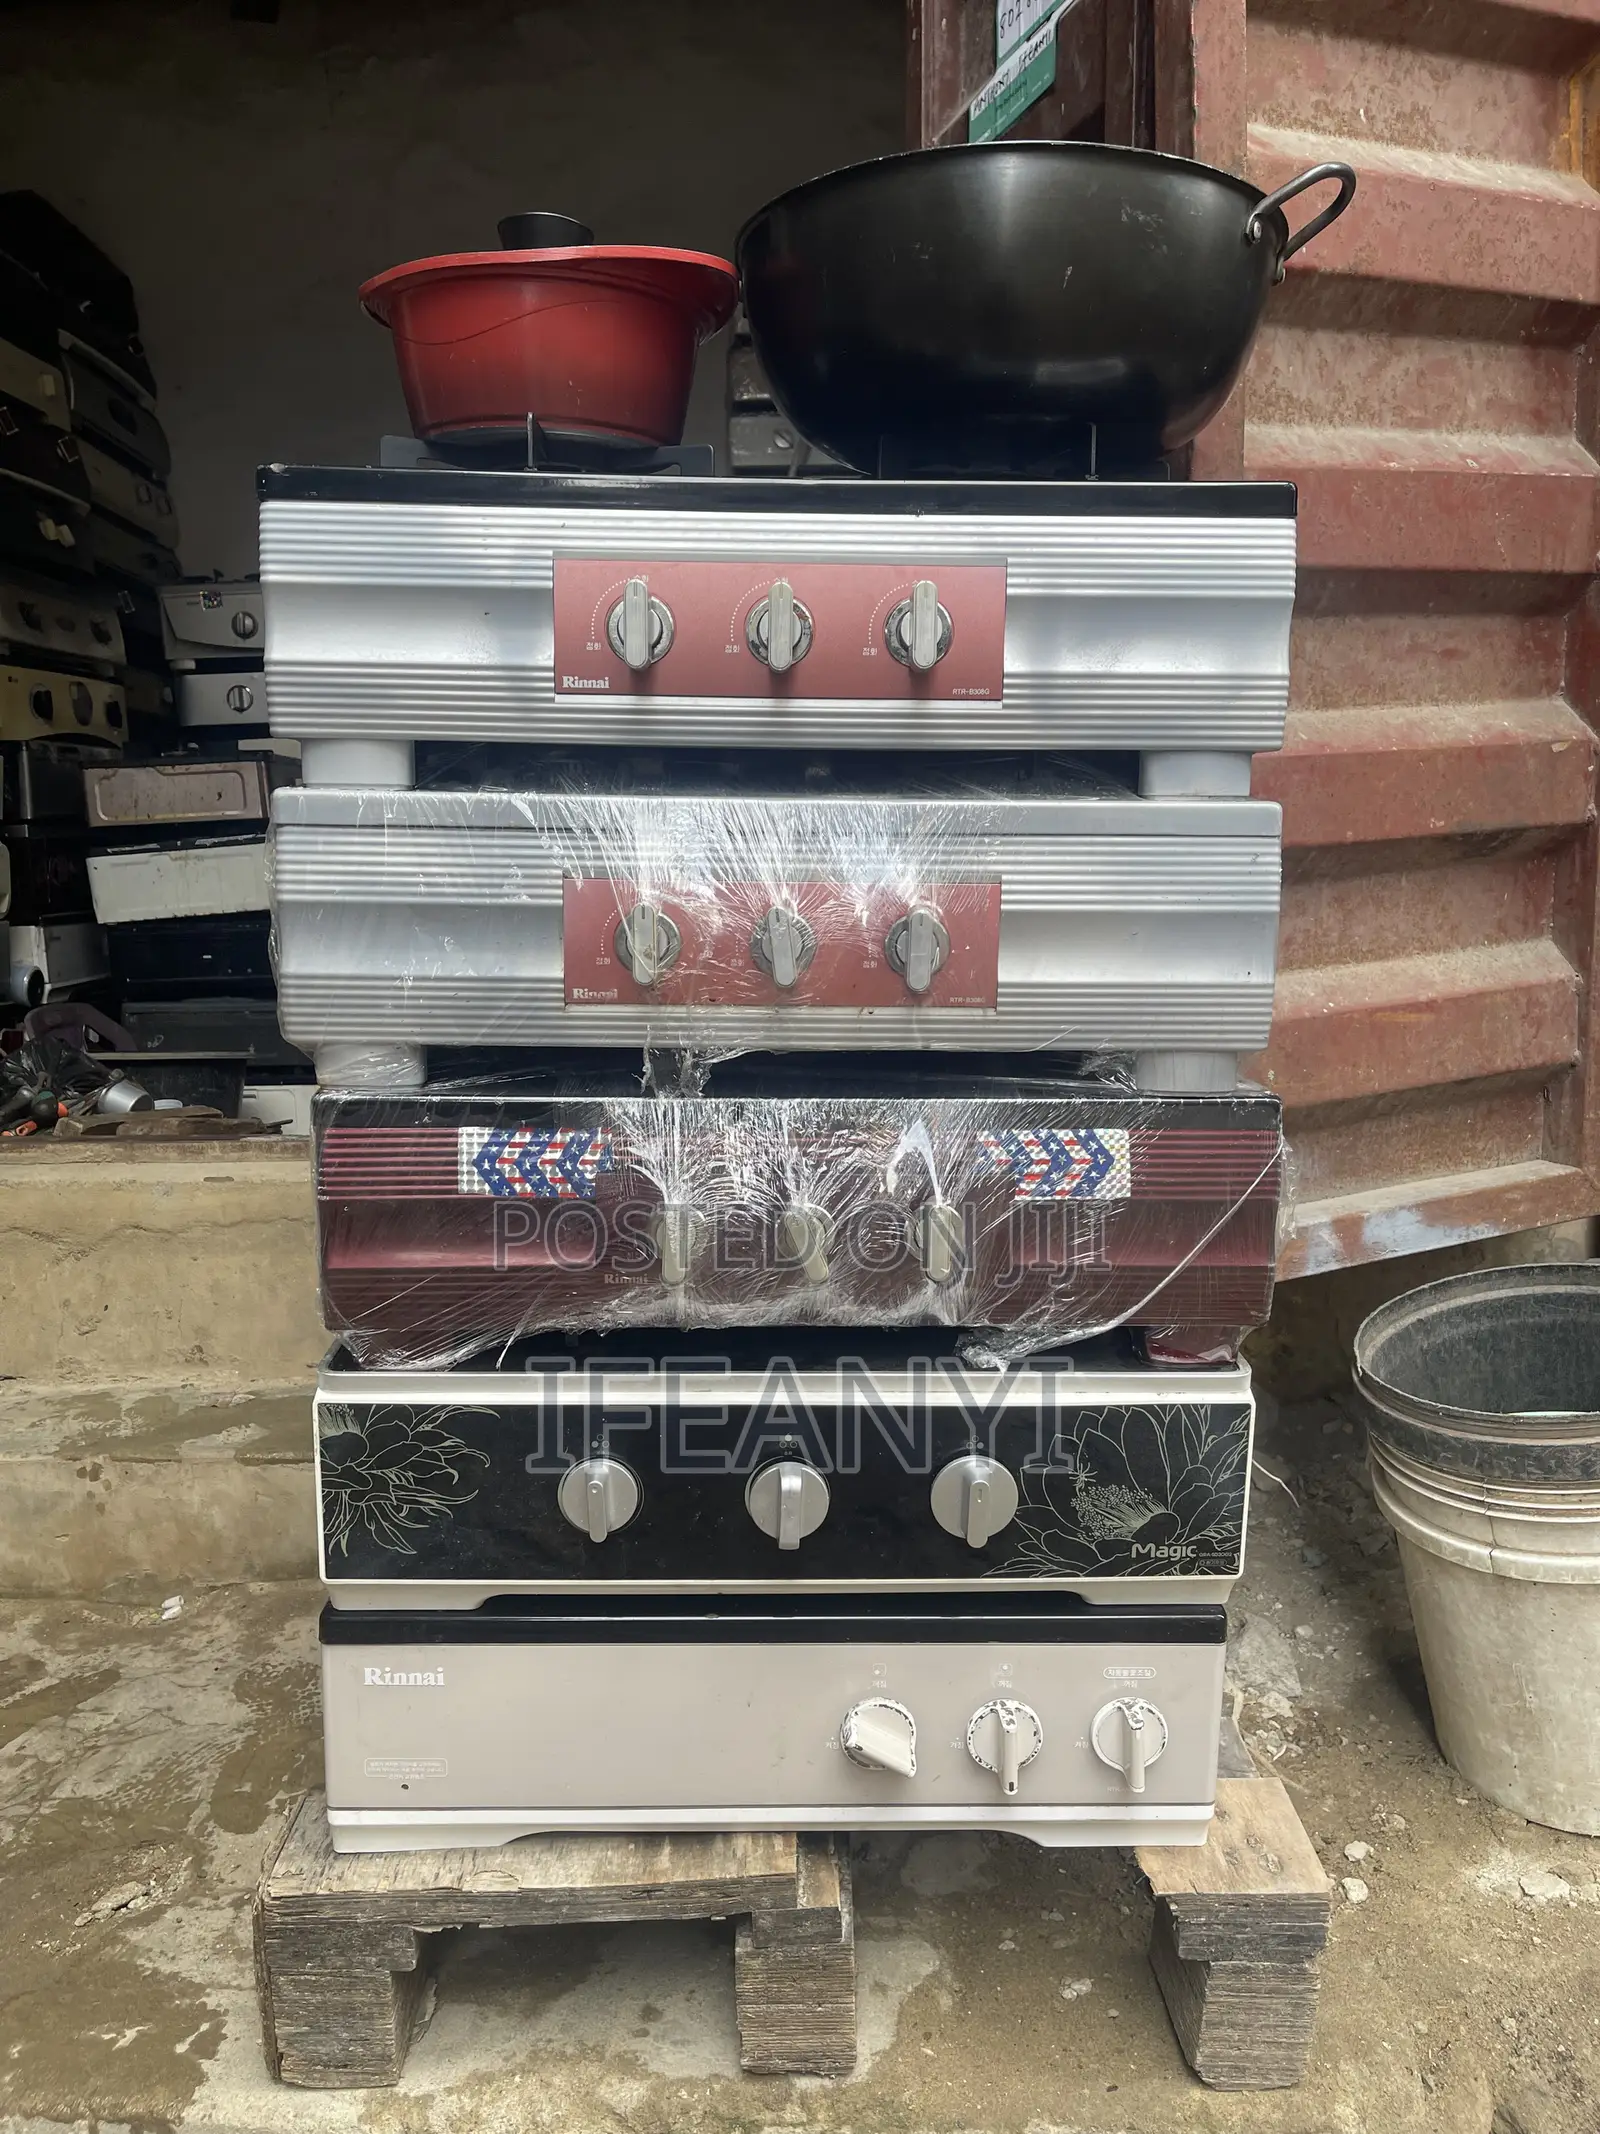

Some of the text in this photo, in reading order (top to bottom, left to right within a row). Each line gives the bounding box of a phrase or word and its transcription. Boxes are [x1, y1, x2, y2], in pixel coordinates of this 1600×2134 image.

[562, 675, 610, 689] Rinnai
[1131, 1543, 1197, 1561] Magic
[363, 1666, 446, 1686] Rinnai
